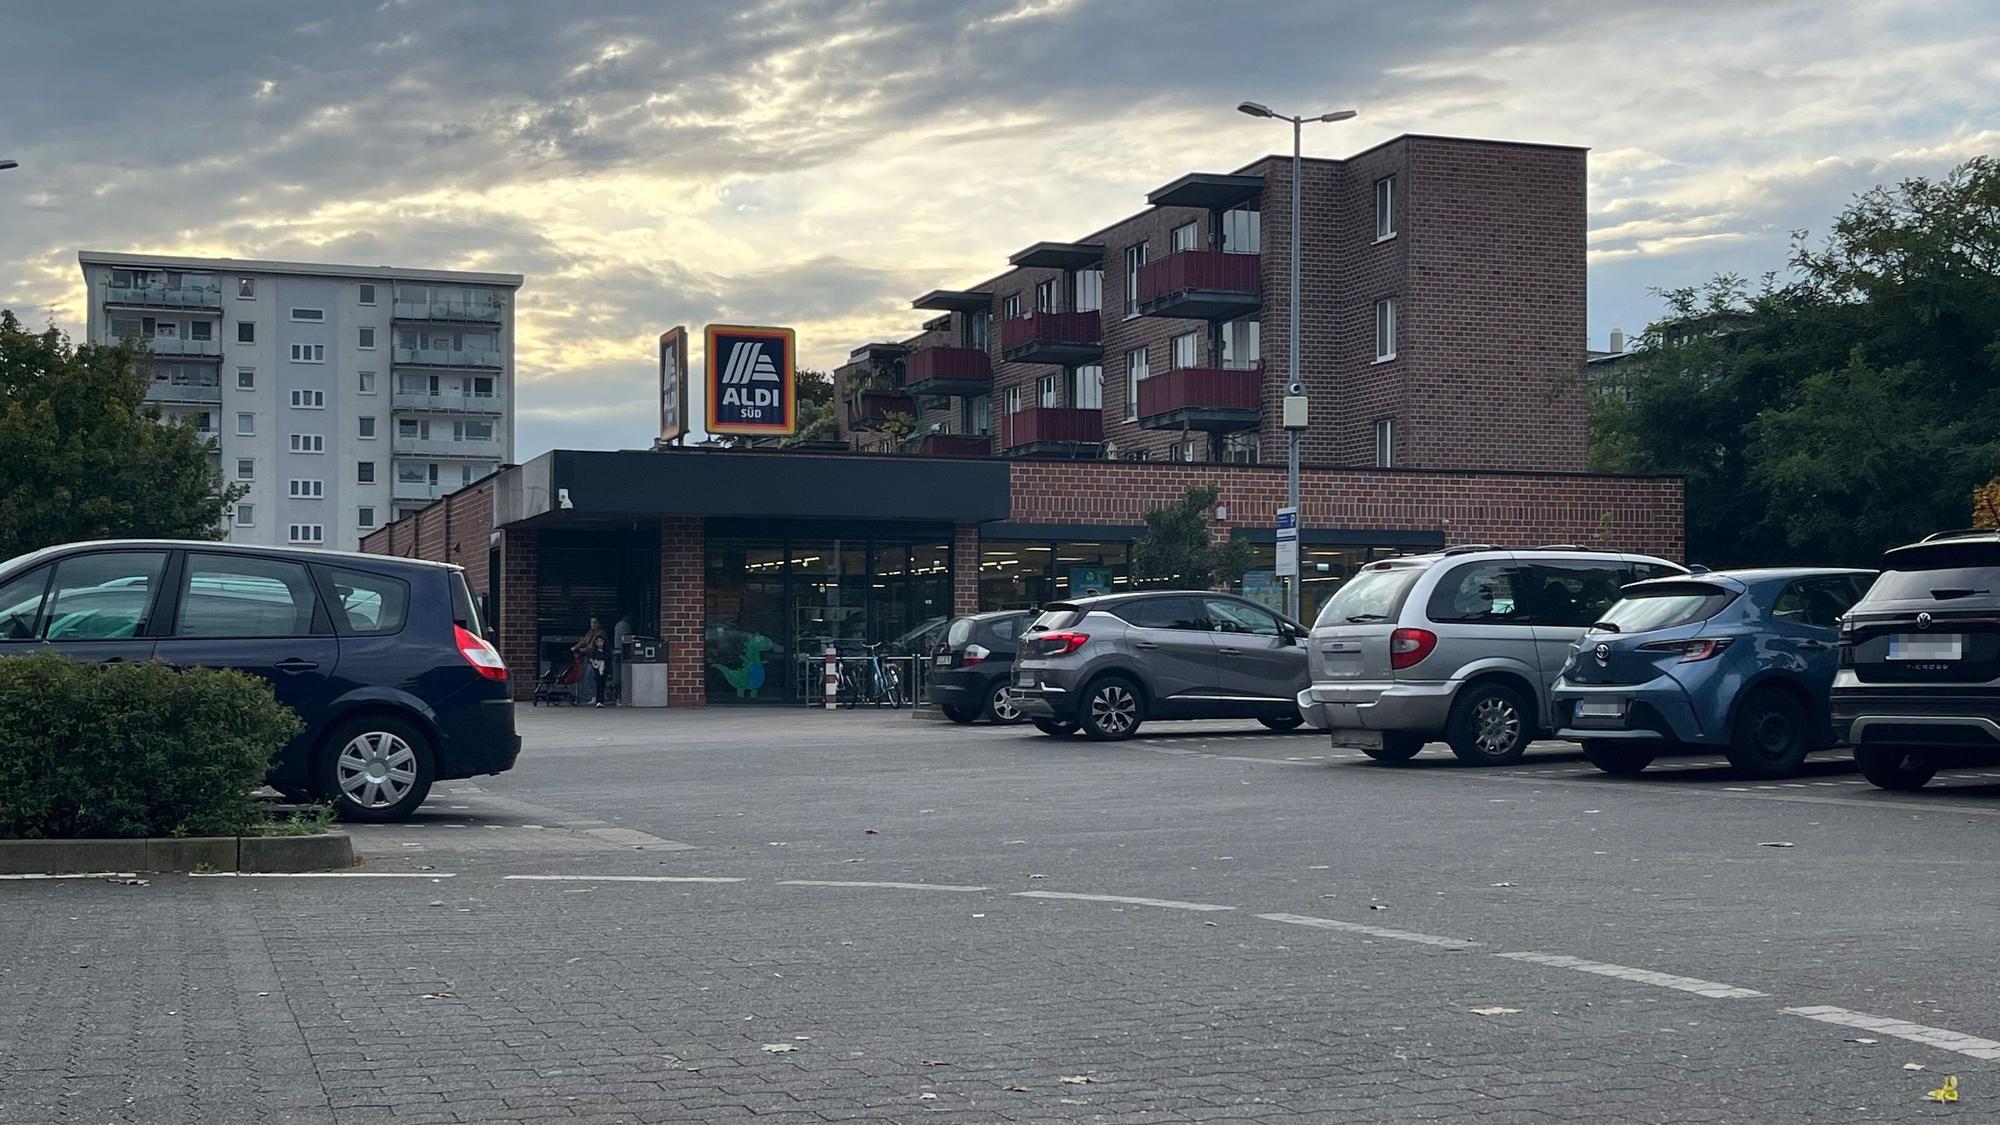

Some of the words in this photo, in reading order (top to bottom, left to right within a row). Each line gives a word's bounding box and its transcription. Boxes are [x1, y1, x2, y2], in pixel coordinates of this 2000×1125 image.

[722, 387, 780, 407] ALDI
[740, 407, 762, 419] SÜD
[1290, 514, 1296, 527] P
